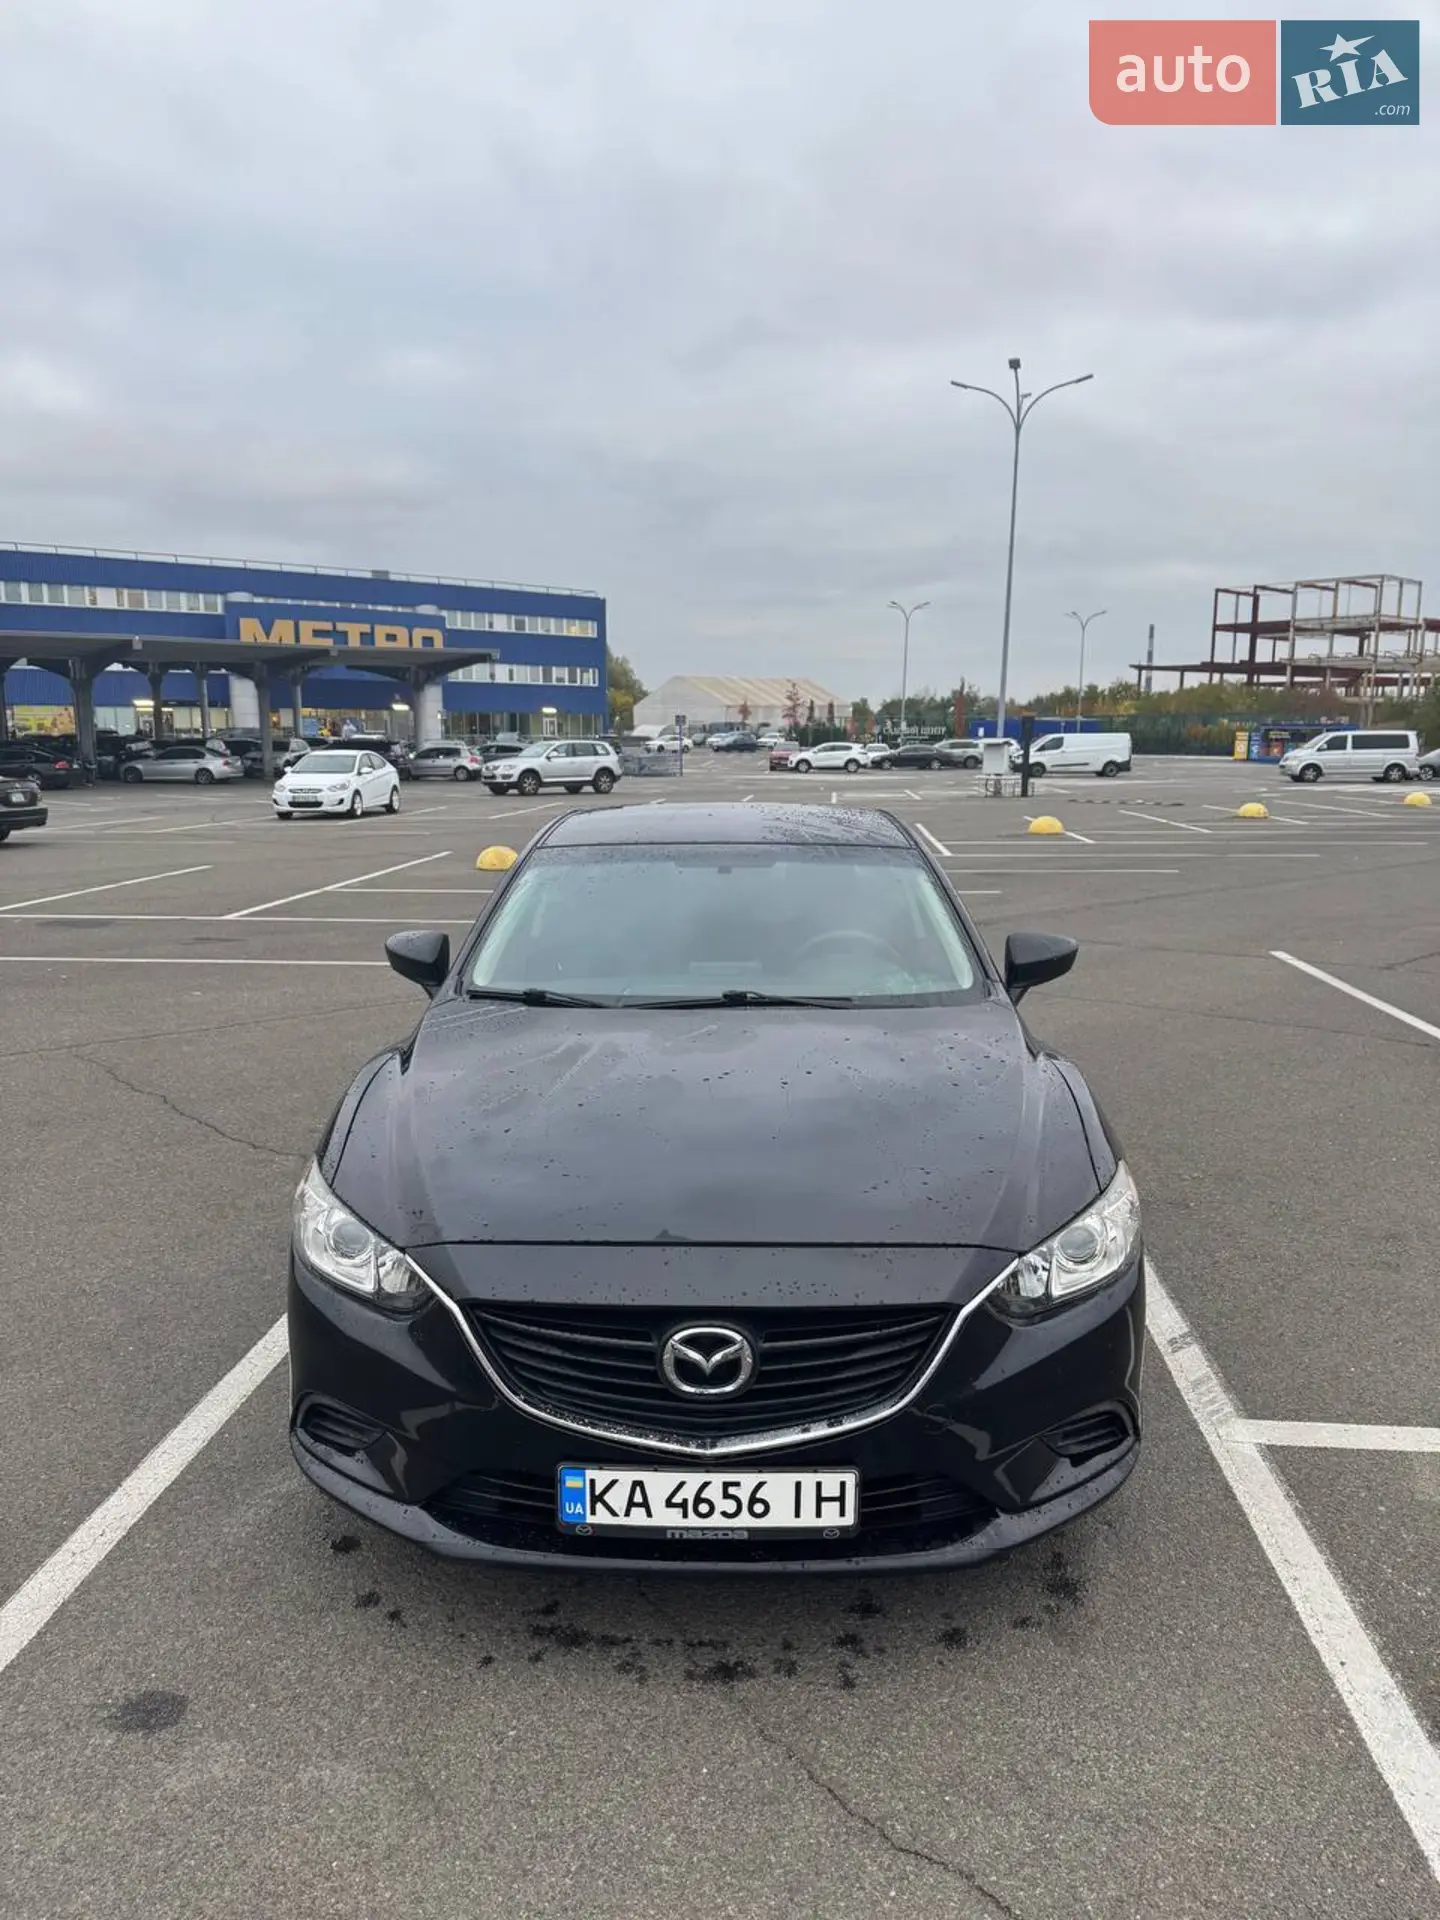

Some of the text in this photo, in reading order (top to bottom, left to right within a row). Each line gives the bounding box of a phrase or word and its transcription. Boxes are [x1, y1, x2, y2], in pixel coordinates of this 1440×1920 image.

[565, 1501, 584, 1515] UA
[588, 1478, 847, 1520] KA 4656 IH
